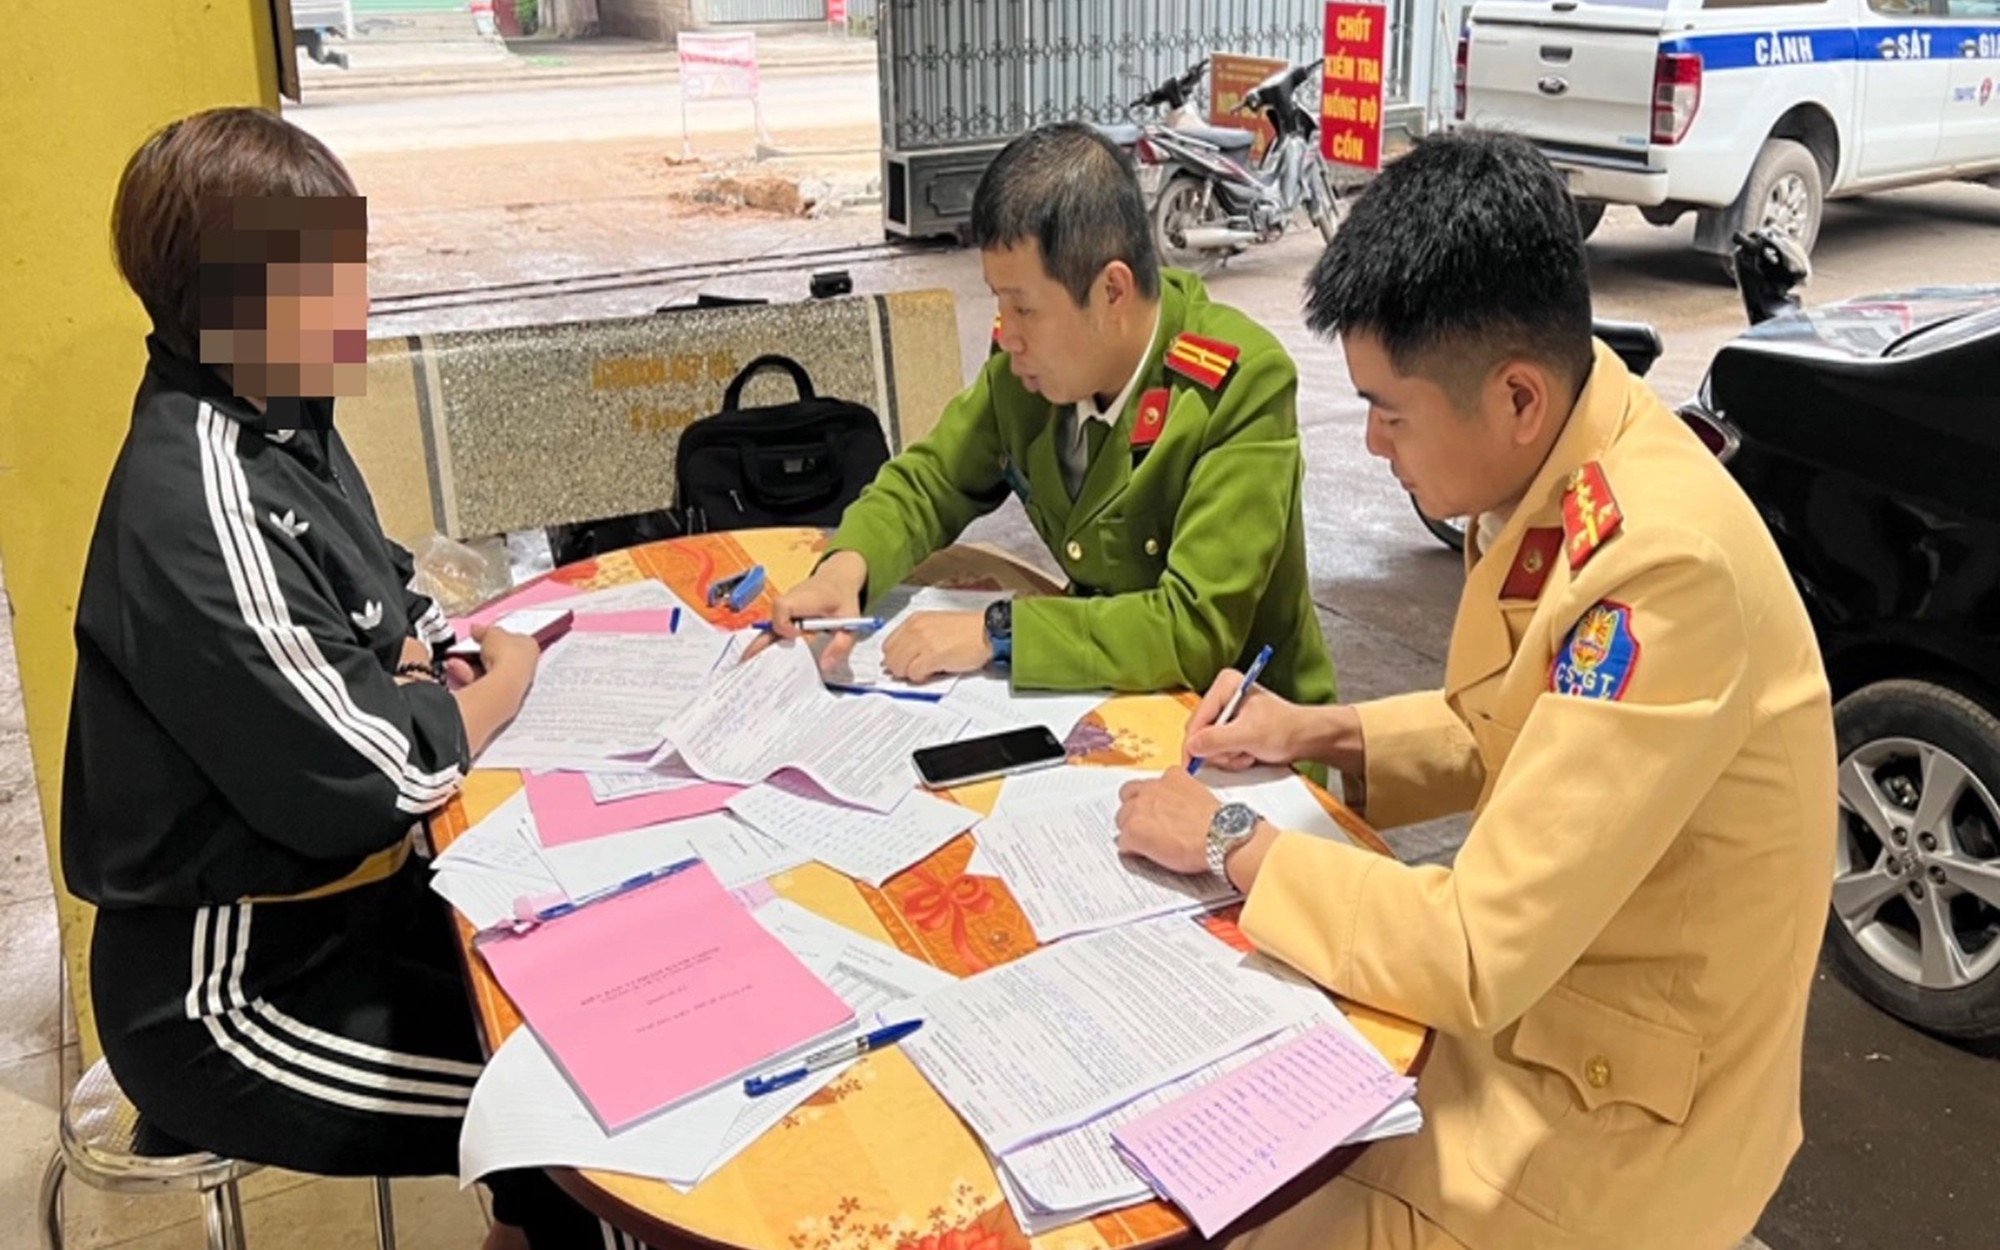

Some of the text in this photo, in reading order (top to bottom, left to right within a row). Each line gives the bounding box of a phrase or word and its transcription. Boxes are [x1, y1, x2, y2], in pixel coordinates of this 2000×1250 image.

[1754, 31, 1814, 65] CẢNH
[1897, 29, 1932, 58] SÁT
[1357, 57, 1380, 83] TRA
[1556, 662, 1615, 695] CSGT
